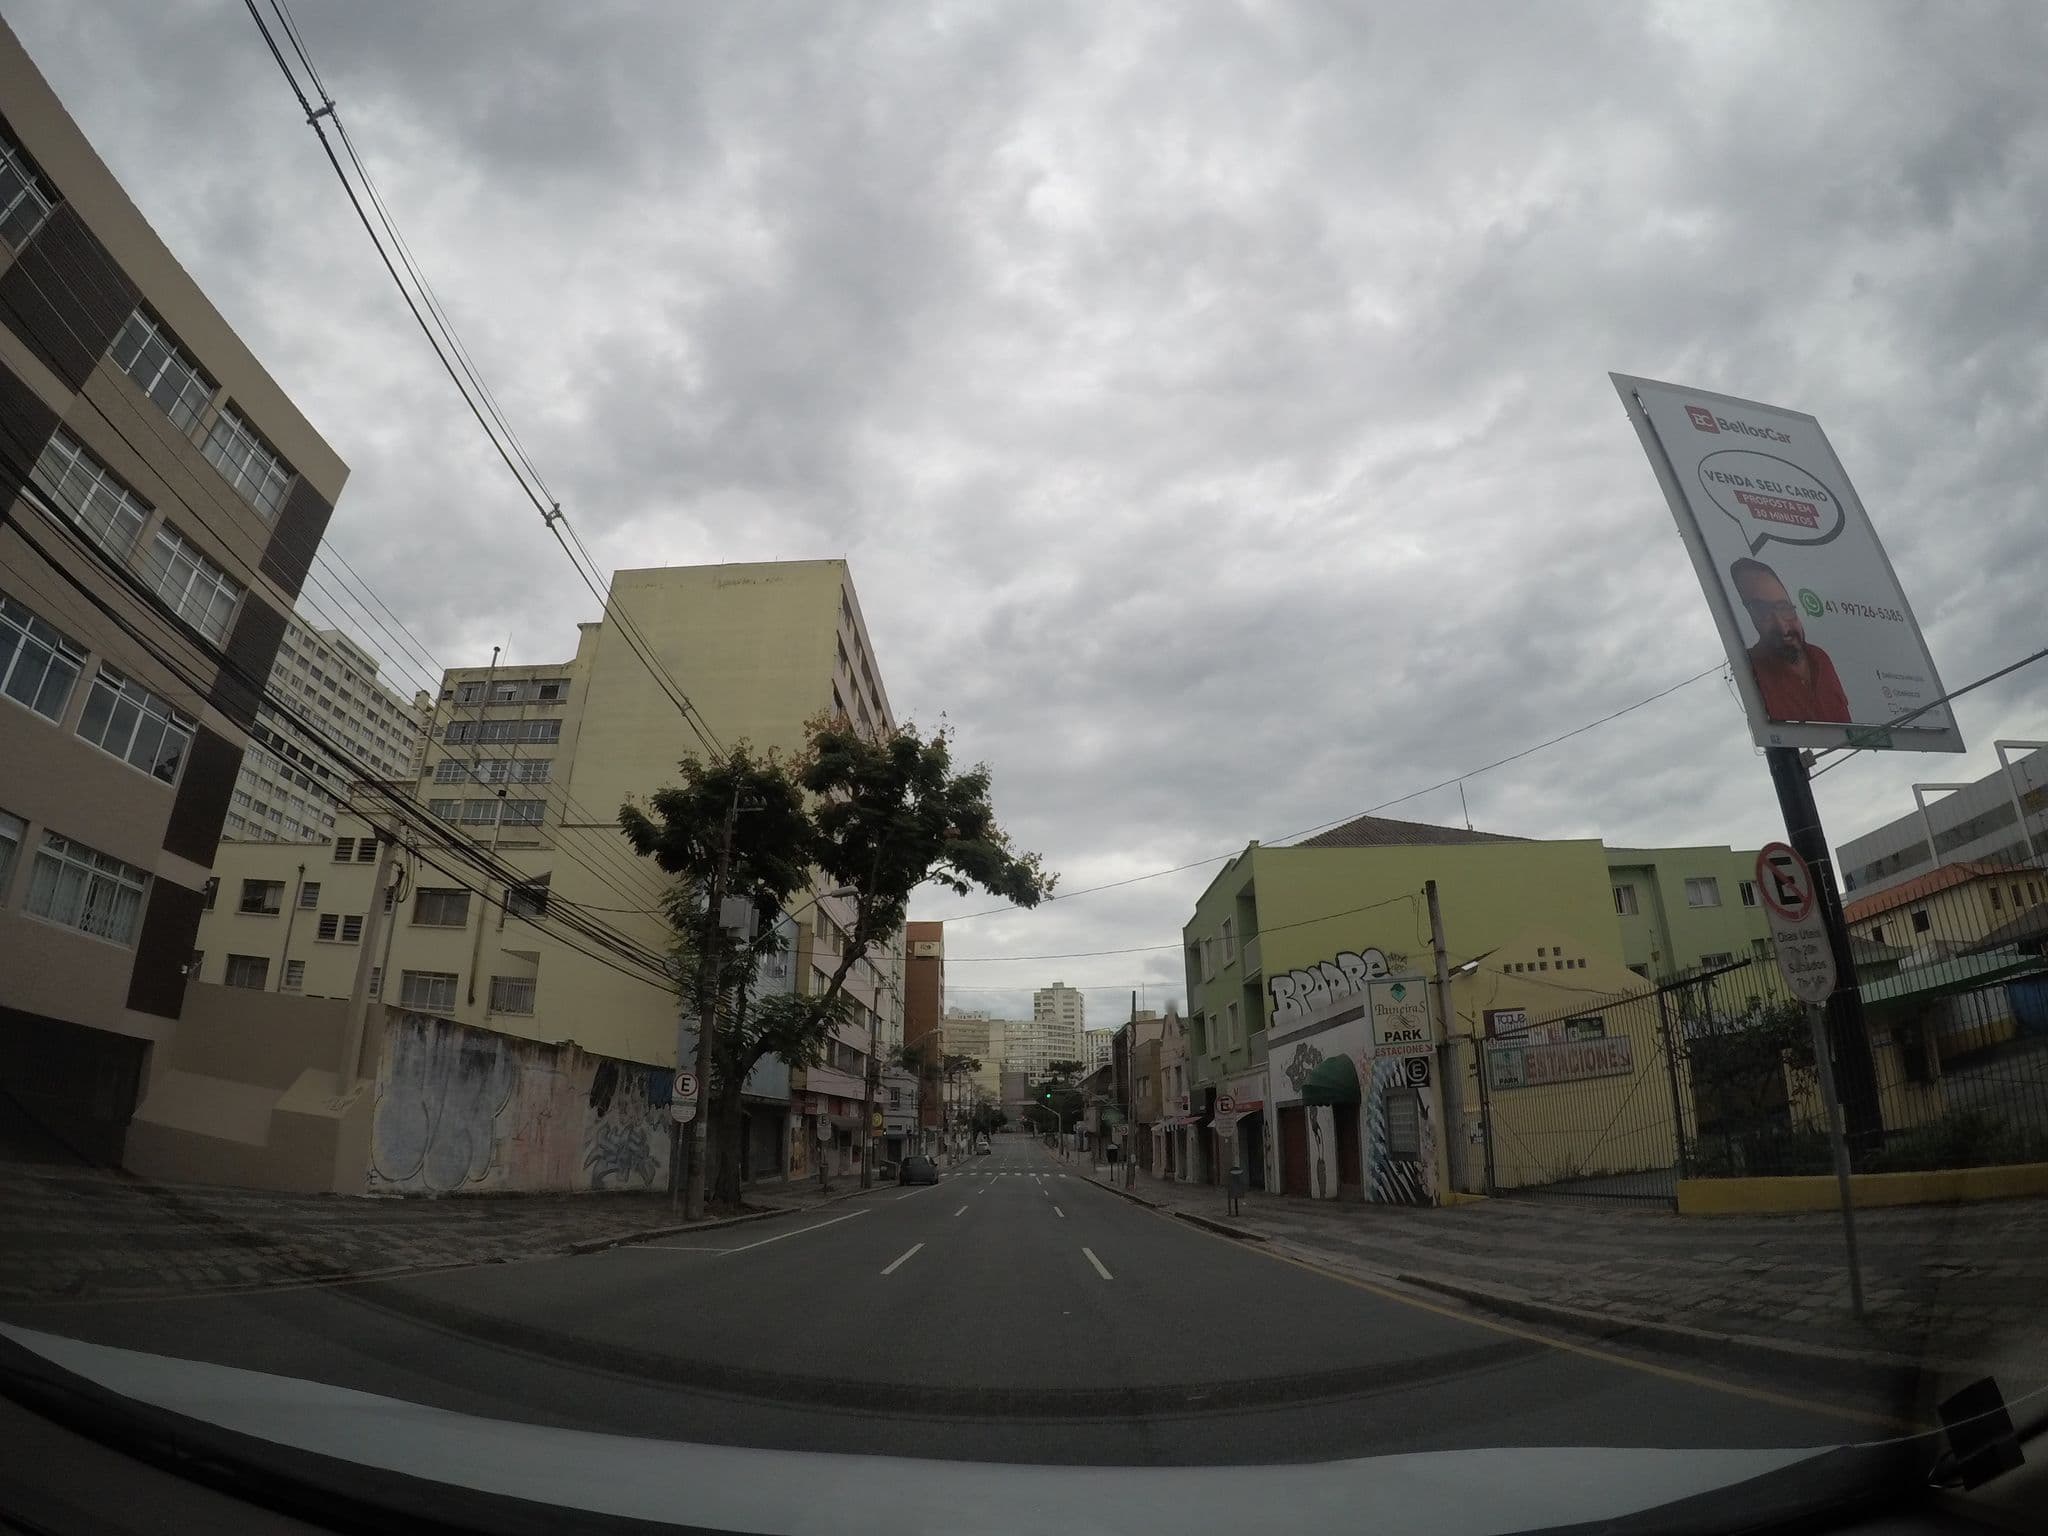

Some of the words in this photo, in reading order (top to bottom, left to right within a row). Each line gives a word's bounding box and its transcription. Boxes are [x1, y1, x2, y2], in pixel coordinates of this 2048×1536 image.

[1716, 416, 1792, 444] BellosCar
[1703, 469, 1755, 489] VENDA
[1755, 479, 1783, 494] SEU
[1785, 485, 1828, 502] CARRO
[1742, 494, 1797, 511] PROPOSTA
[1796, 503, 1813, 513] EM
[1754, 508, 1768, 517] 30
[1769, 511, 1813, 526] MINUTOS
[1825, 600, 1839, 613] 41
[1384, 1028, 1422, 1042] PARK
[1375, 1044, 1425, 1057] ESTACIONE
[681, 1077, 691, 1092] E
